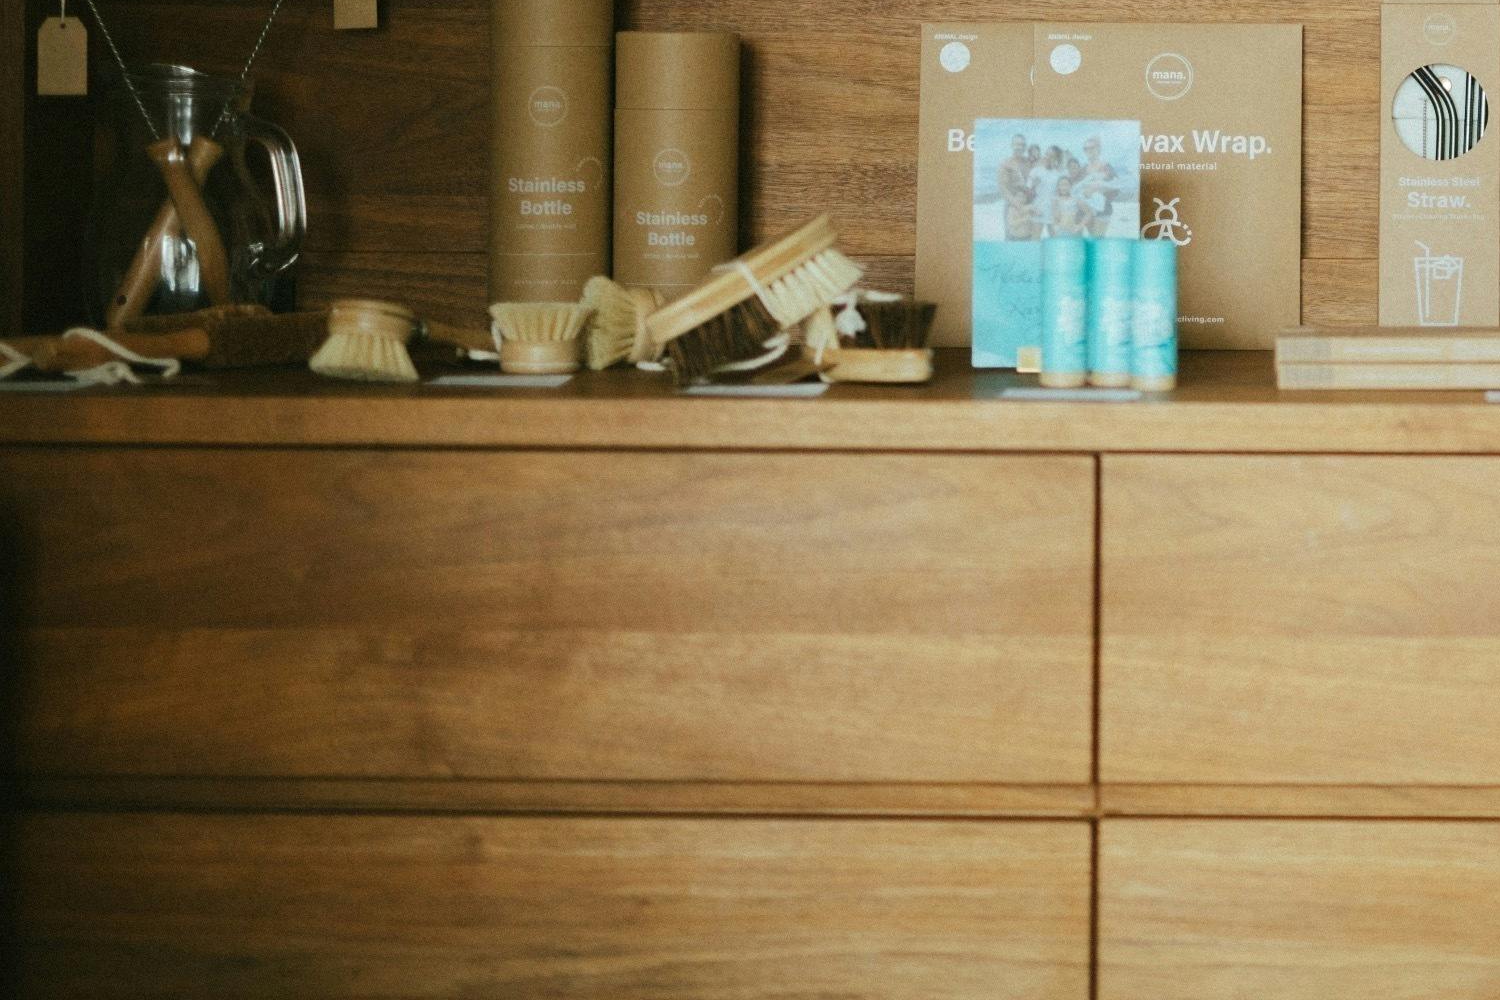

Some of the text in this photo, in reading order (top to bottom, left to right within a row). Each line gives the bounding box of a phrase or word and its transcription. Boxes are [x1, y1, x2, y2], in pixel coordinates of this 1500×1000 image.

[1152, 71, 1186, 80] mana.
[1192, 130, 1272, 159] Wrap.
[1138, 161, 1217, 171] natural material
[508, 177, 586, 194] Stainless
[1398, 176, 1480, 187] Stainless Steel
[1407, 191, 1471, 208] Straw.
[520, 200, 572, 216] Bottle
[636, 210, 708, 227] Stainless
[647, 231, 696, 247] Bottle
[1177, 315, 1225, 324] cliving.com
